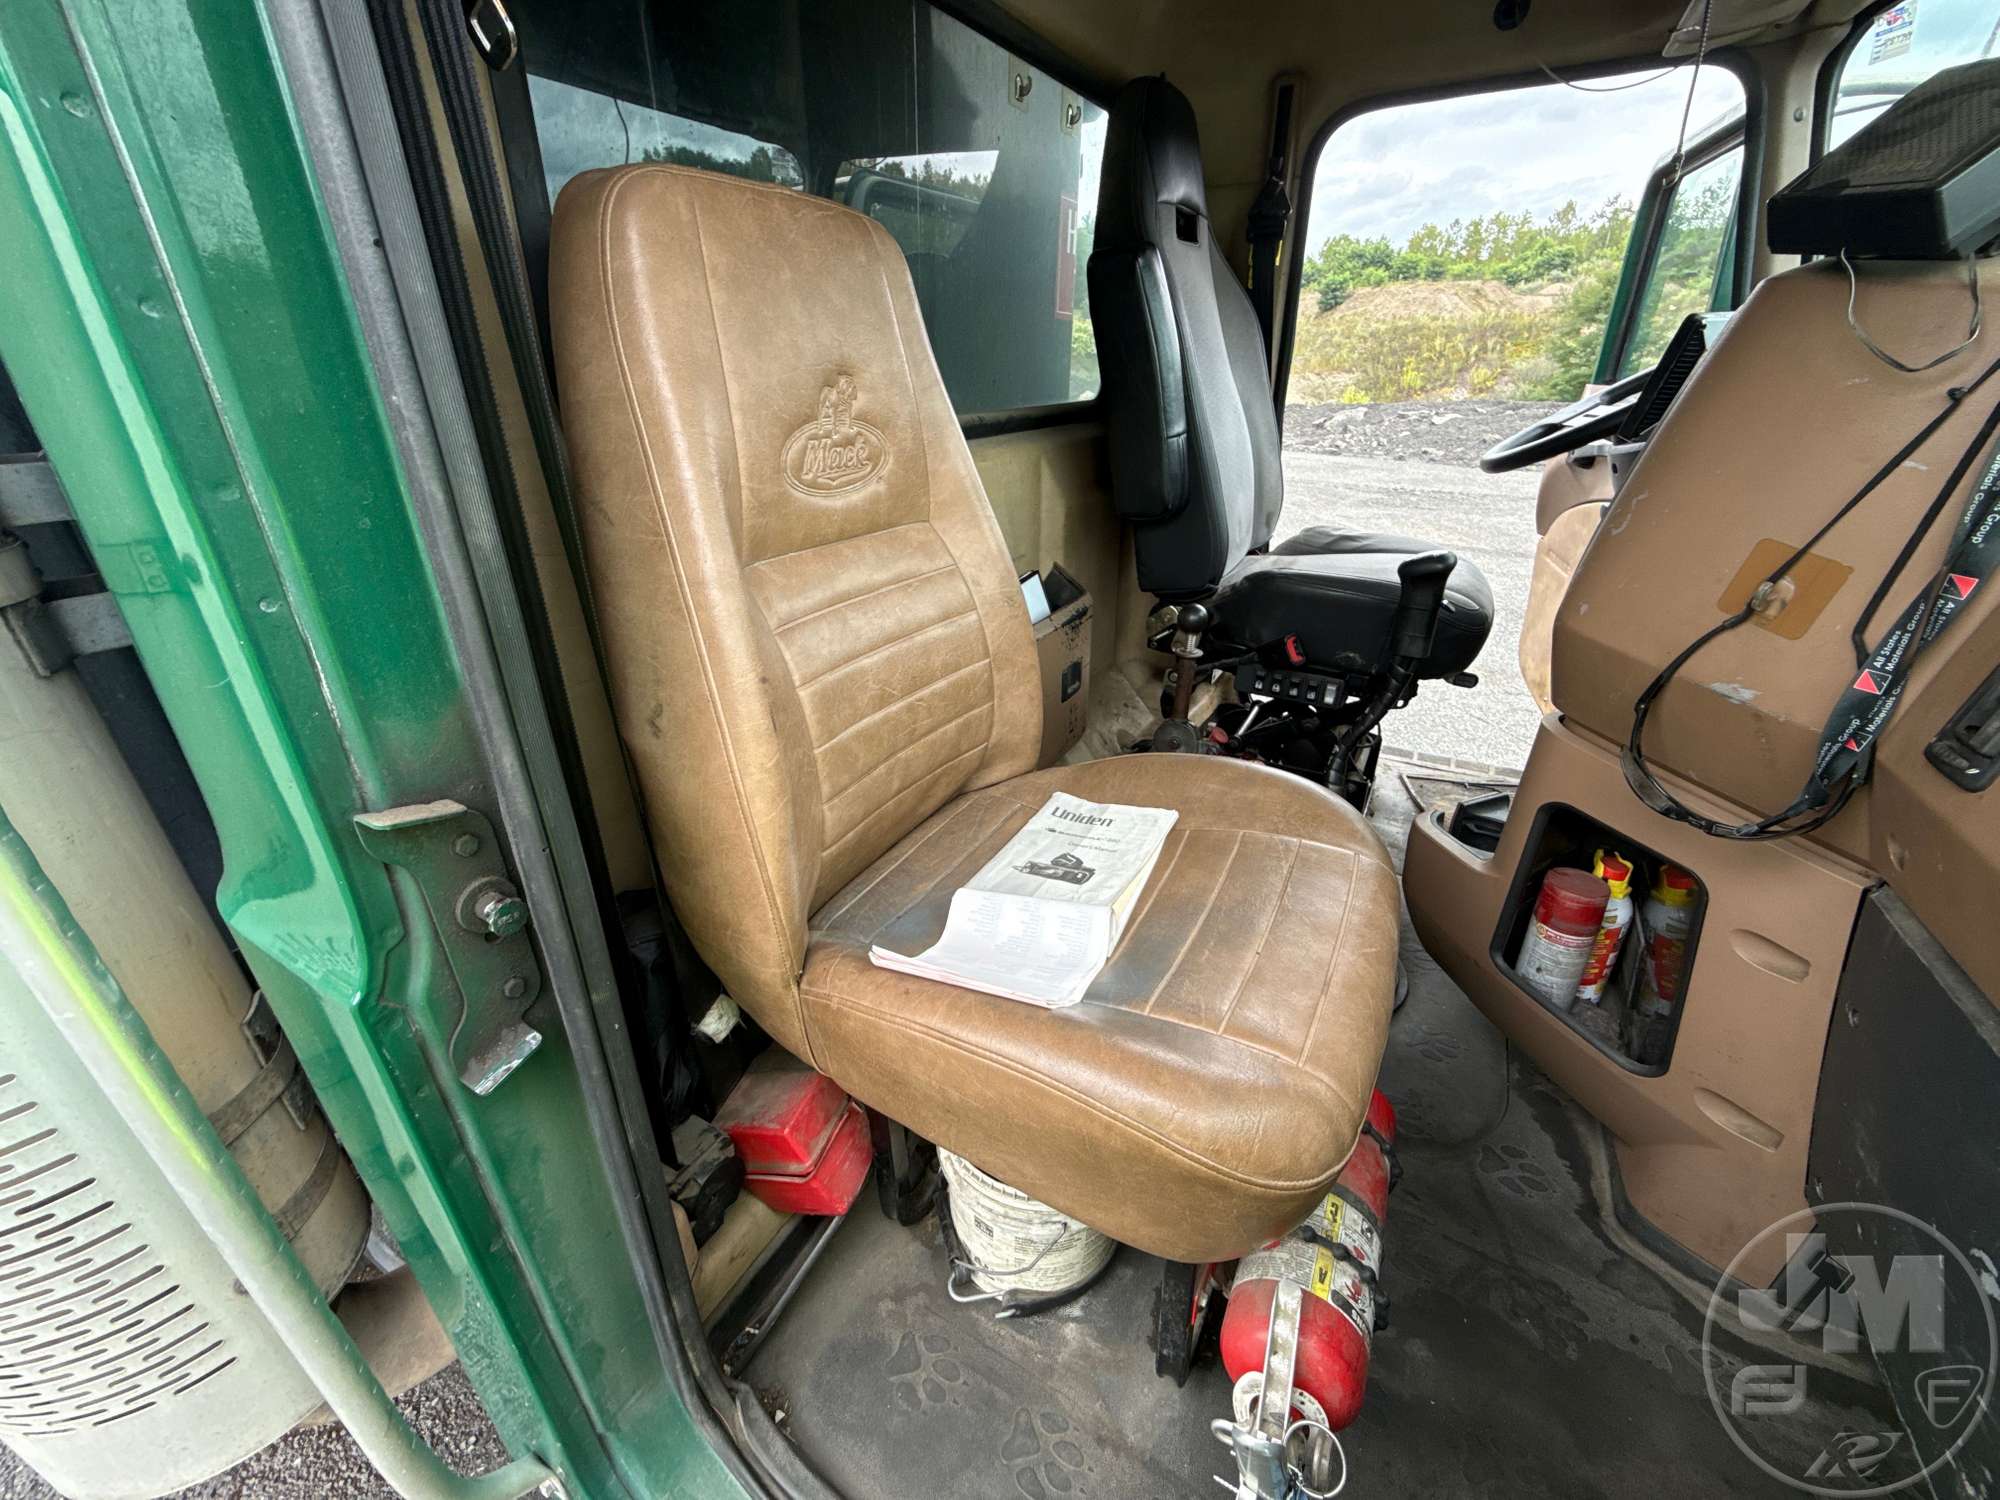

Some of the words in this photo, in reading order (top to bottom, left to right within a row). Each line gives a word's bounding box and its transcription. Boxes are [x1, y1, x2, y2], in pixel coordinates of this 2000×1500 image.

[800, 431, 870, 480] Mack
[1980, 454, 2000, 490] aterials
[1964, 492, 1985, 523] Group
[1971, 513, 2000, 544] Group
[1873, 655, 1887, 669] All
[1881, 630, 1902, 656] States
[1885, 633, 1911, 672] Materials
[1907, 602, 1926, 631] Group
[1838, 718, 1861, 742] Group
[1865, 696, 1896, 733] Materials
[1051, 806, 1114, 828] Uniden
